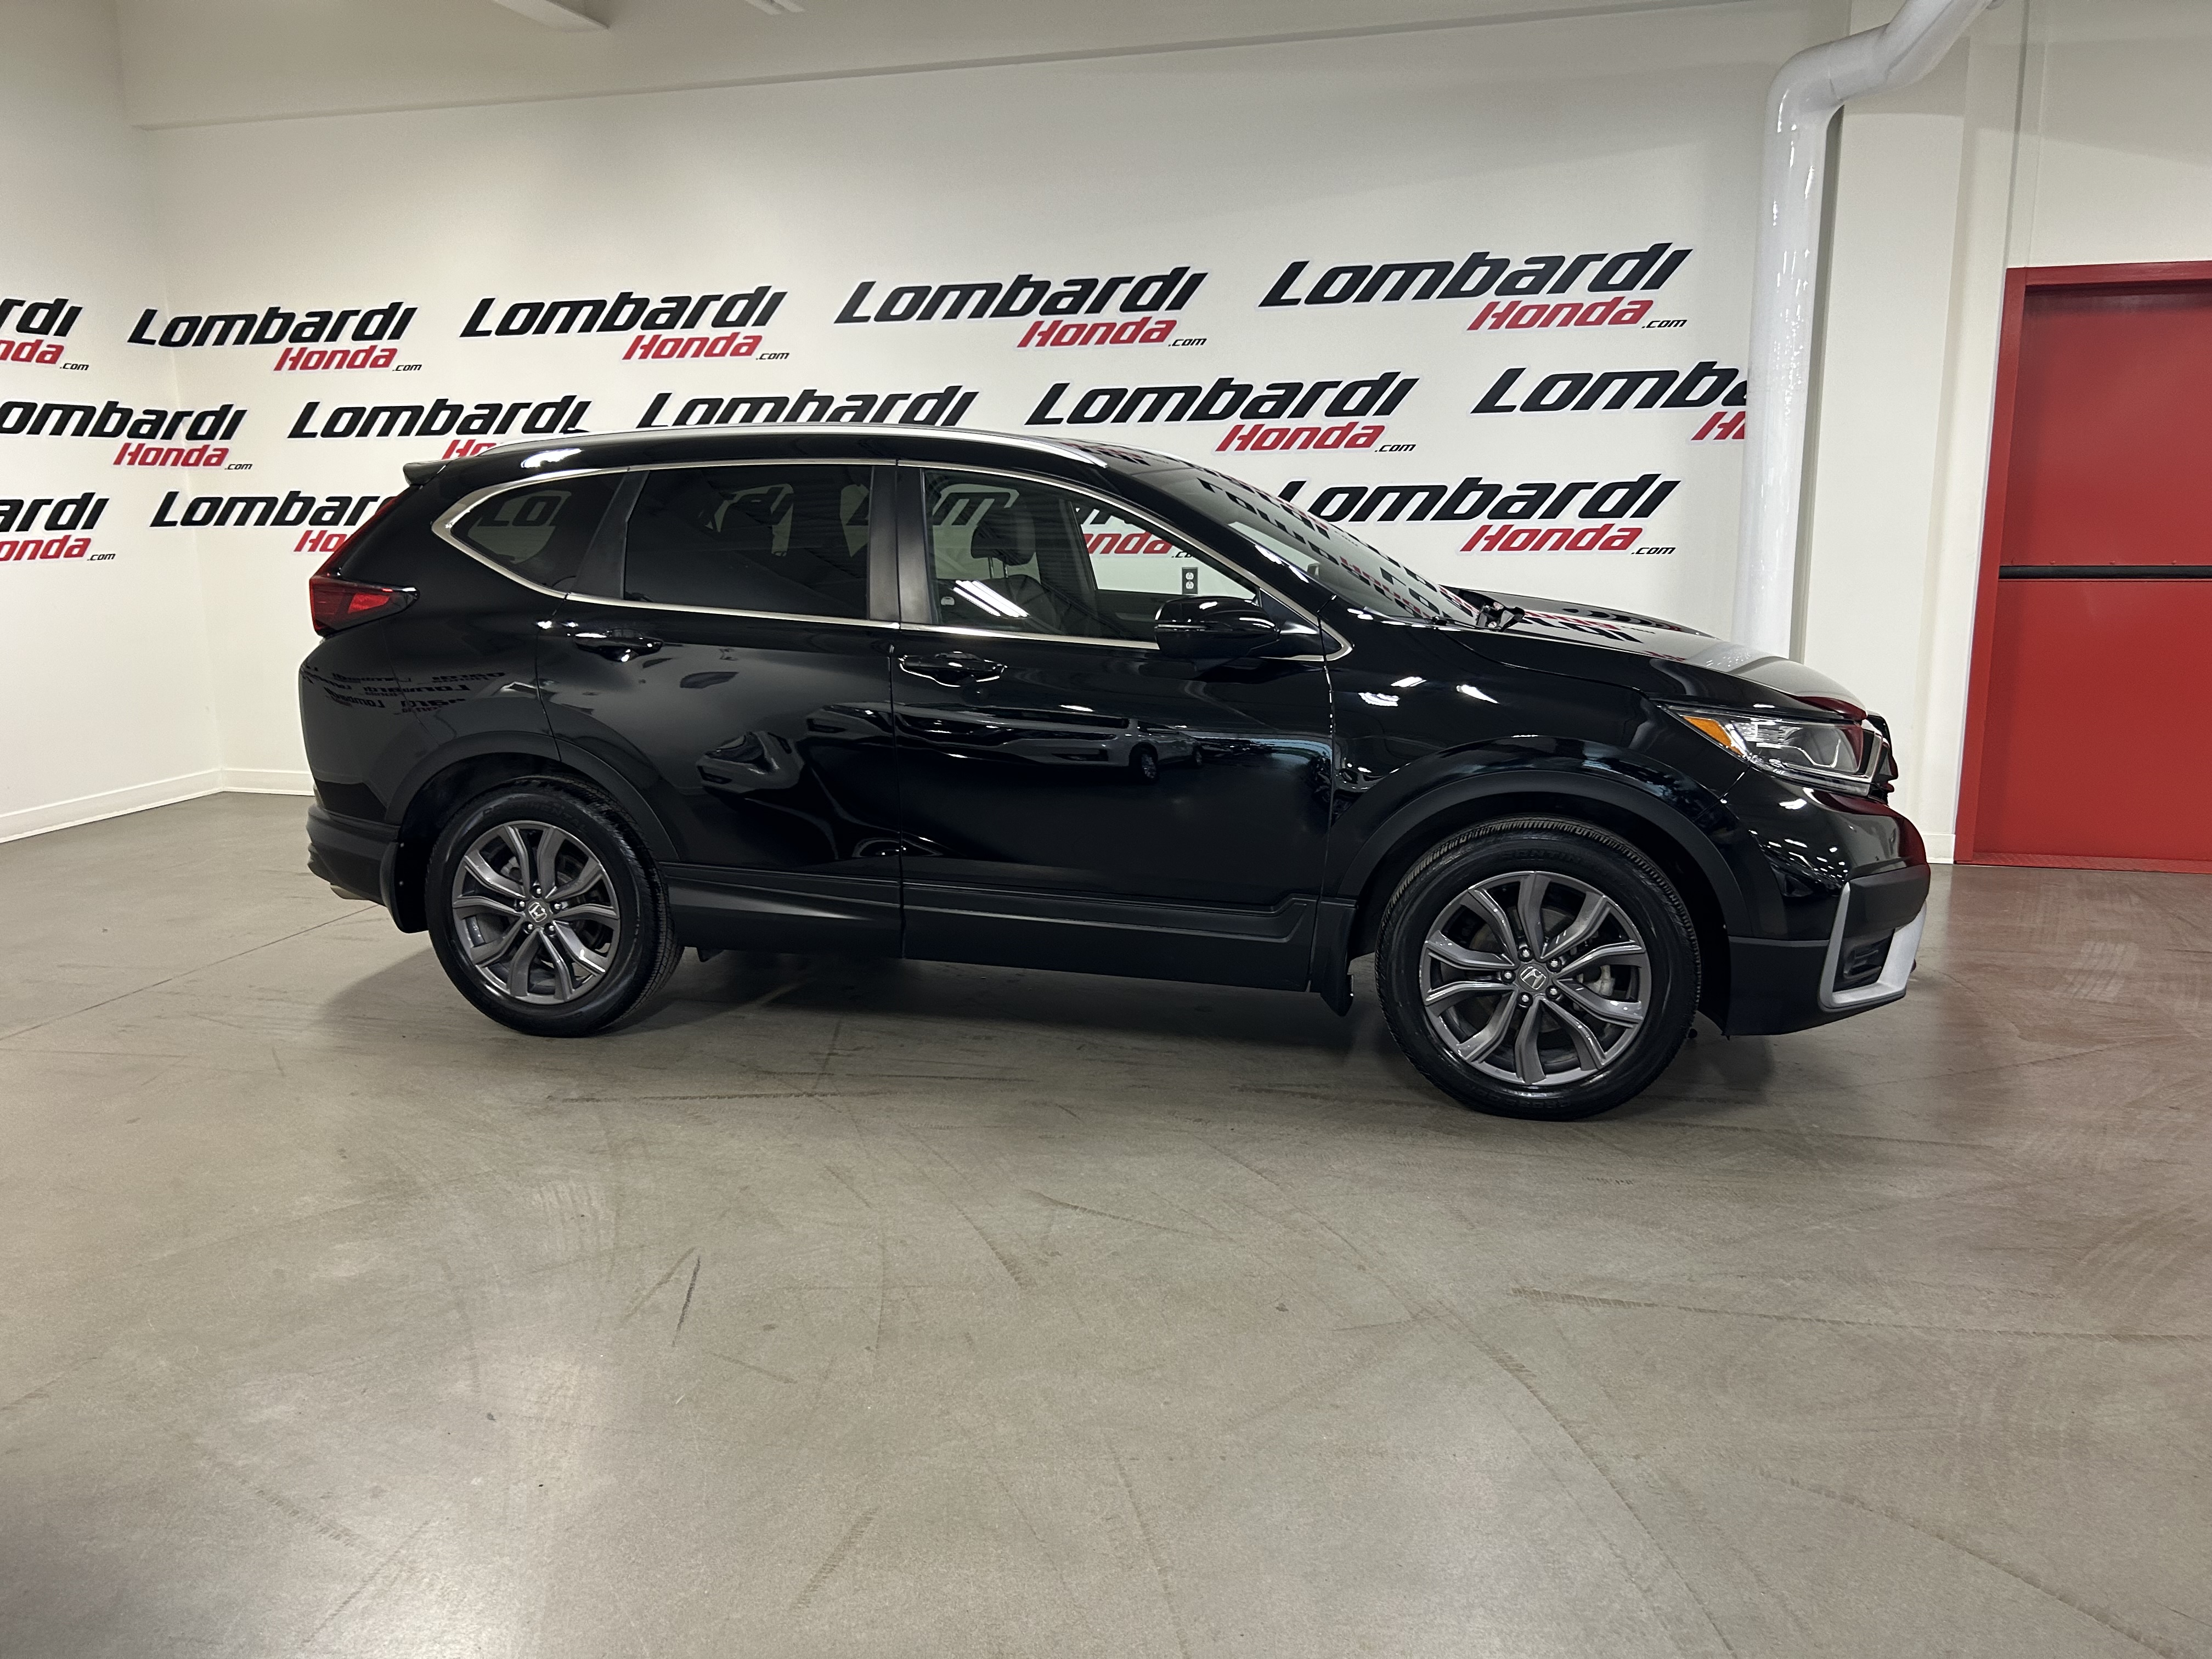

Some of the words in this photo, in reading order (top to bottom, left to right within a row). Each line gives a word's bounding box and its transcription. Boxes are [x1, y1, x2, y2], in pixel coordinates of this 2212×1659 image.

[1258, 242, 1694, 308] Lombardi
[459, 285, 788, 338] Lombardi
[833, 266, 1209, 324] Lombardi
[1467, 296, 1654, 330] Honda
[1641, 319, 1688, 329] .com
[127, 301, 418, 348] Lombardi
[1017, 317, 1177, 348] Honda
[1168, 338, 1207, 347] .com
[274, 345, 398, 371] Honda
[622, 332, 763, 360] Honda
[59, 363, 89, 371] .com
[636, 385, 980, 426] Lombardi
[1024, 371, 1420, 426] Lombardi
[1470, 361, 1747, 414] Lomb
[0, 400, 248, 441] ombardi
[287, 394, 592, 438] Lombardi
[113, 442, 229, 467] Honda
[1215, 421, 1385, 452] Honda
[1374, 444, 1417, 453] .com
[0, 492, 110, 532] ardi
[149, 490, 397, 527] Lombar
[0, 534, 92, 561] onda
[1460, 523, 1643, 552] Honda
